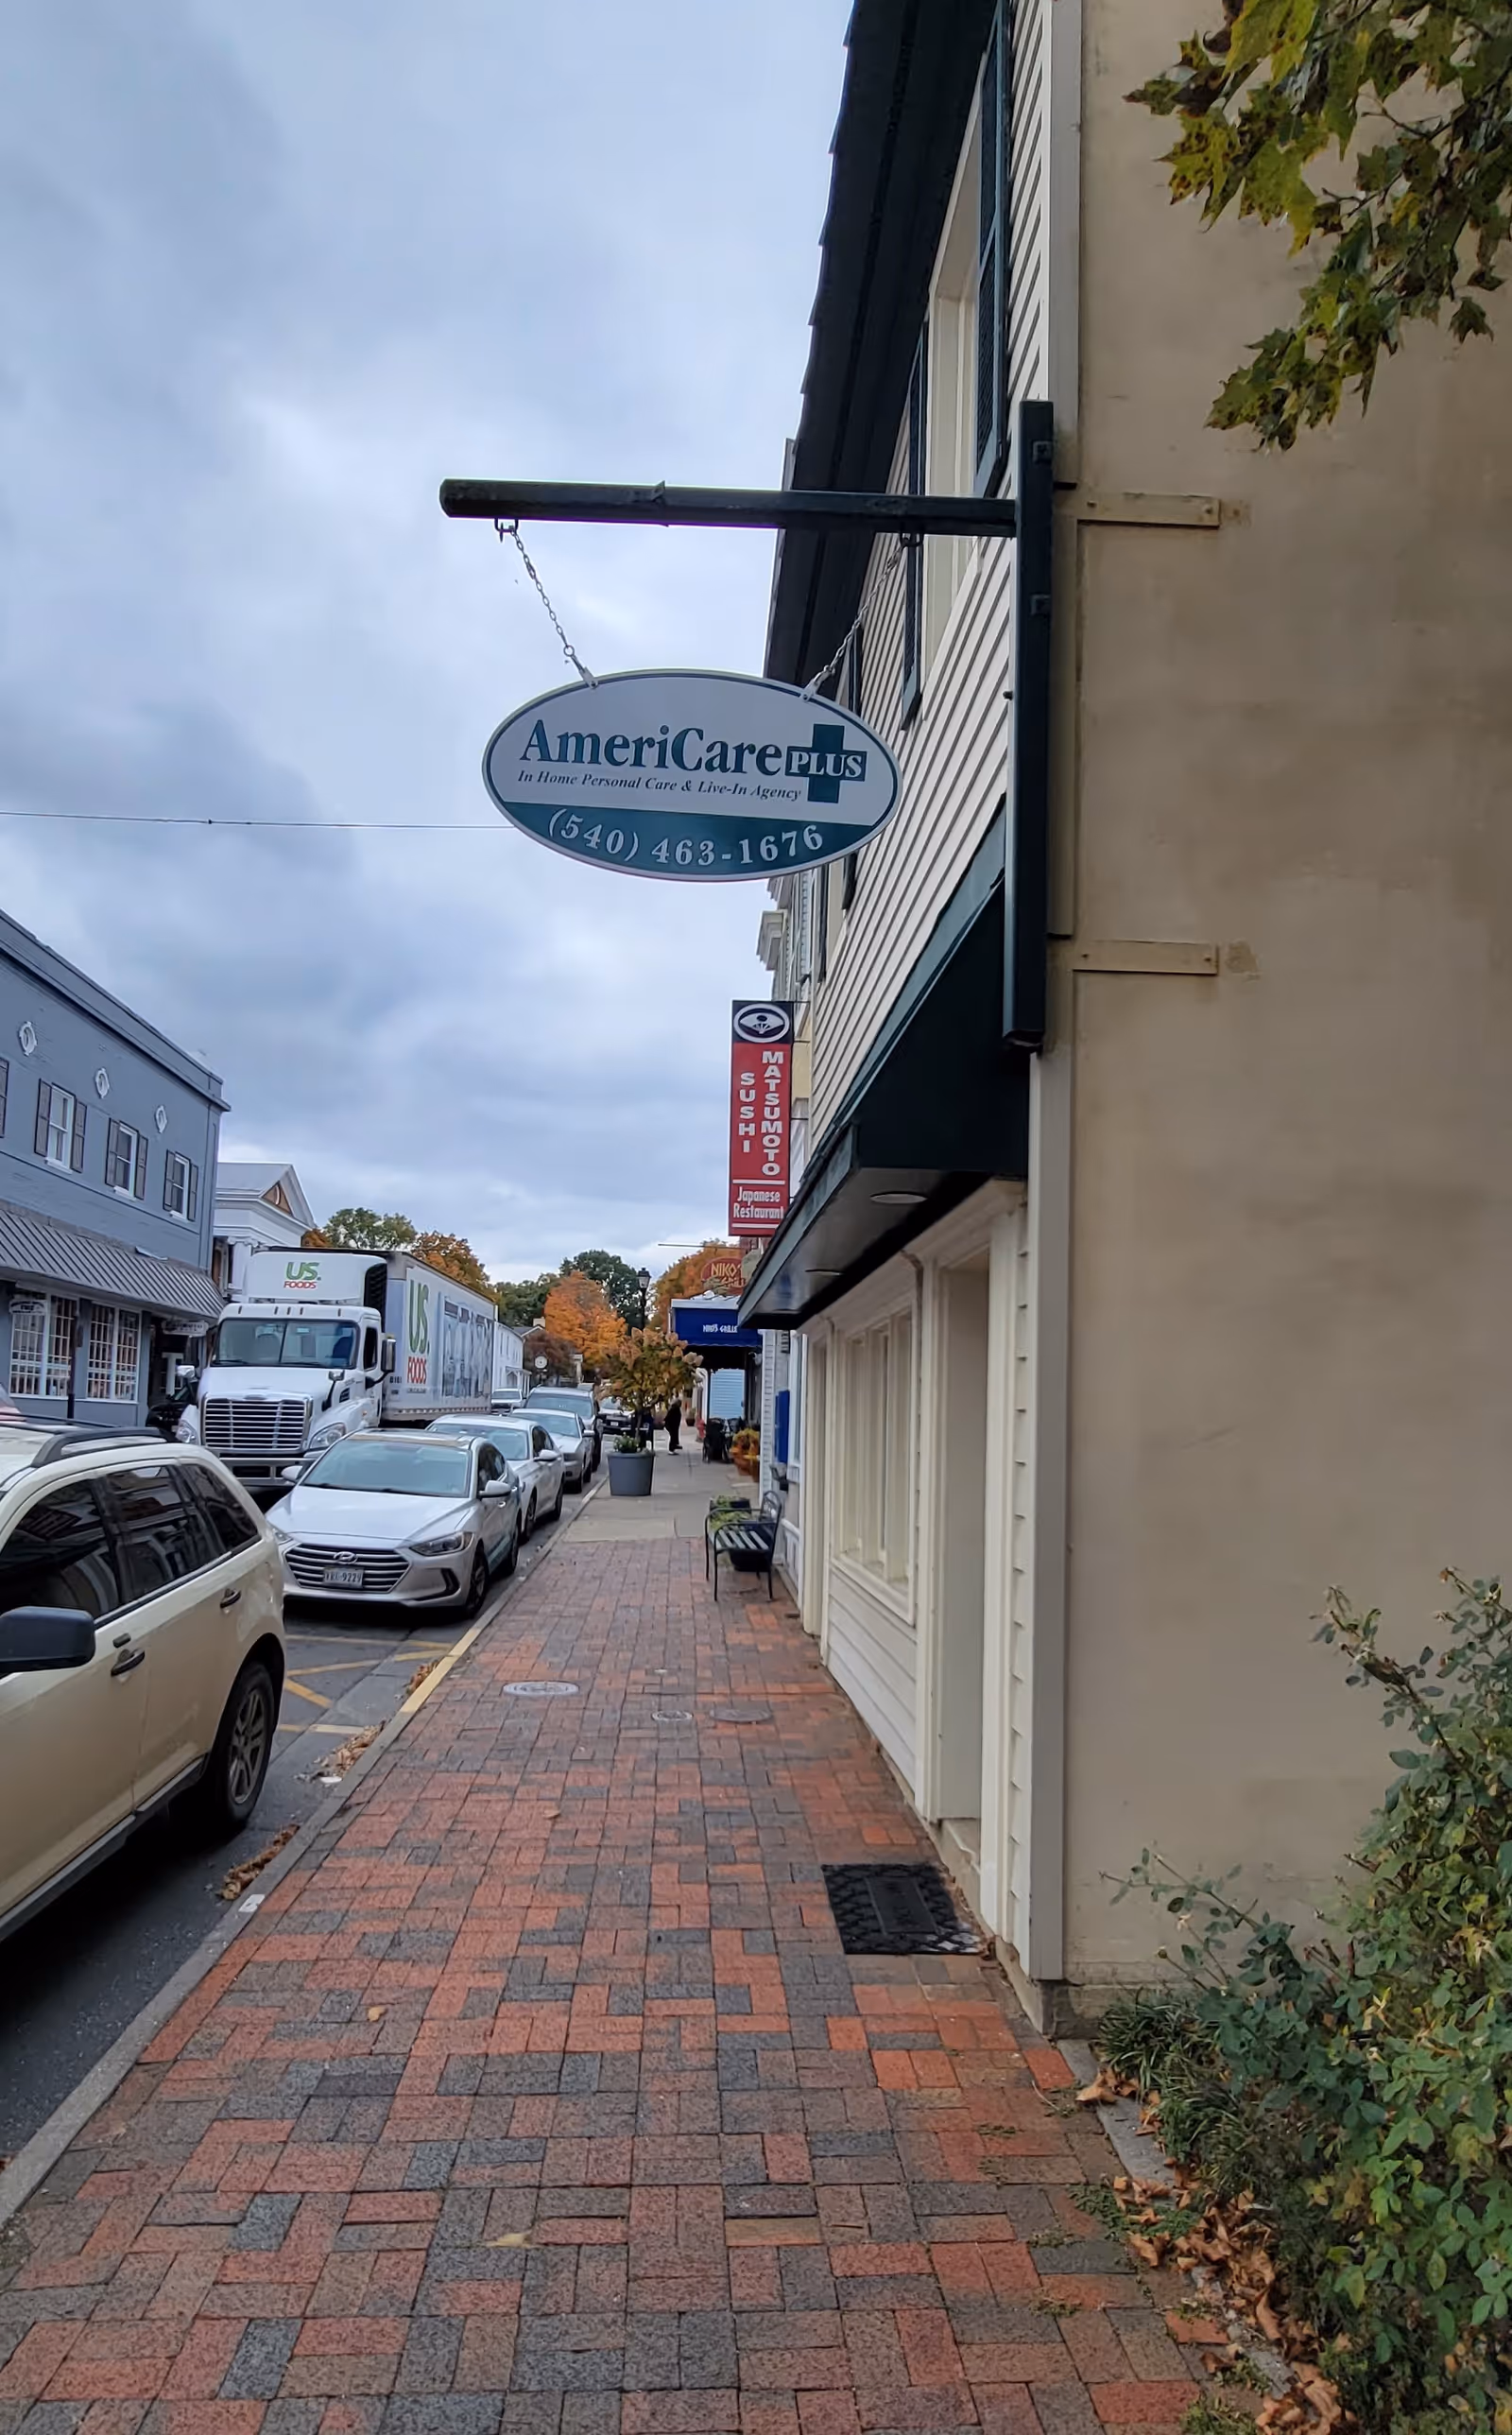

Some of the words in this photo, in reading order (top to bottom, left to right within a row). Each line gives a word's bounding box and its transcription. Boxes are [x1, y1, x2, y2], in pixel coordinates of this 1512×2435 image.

[788, 751, 863, 778] PLUS
[518, 769, 533, 783] In
[537, 770, 577, 785] Home
[581, 773, 642, 788] Personal
[644, 777, 678, 791] Care
[680, 780, 693, 792] &
[697, 781, 747, 796] Live-In
[749, 785, 802, 803] Agency
[548, 808, 639, 862] (540)
[651, 824, 823, 866] 463-1676
[738, 1072, 756, 1153] SUSHI
[761, 1050, 783, 1176] MATSUMOTO
[737, 1186, 781, 1206] Japanese
[733, 1202, 784, 1219] Restaurant
[711, 1262, 743, 1278] NIKO'
[284, 1281, 317, 1289] FOODS
[407, 1356, 427, 1385] FOODS
